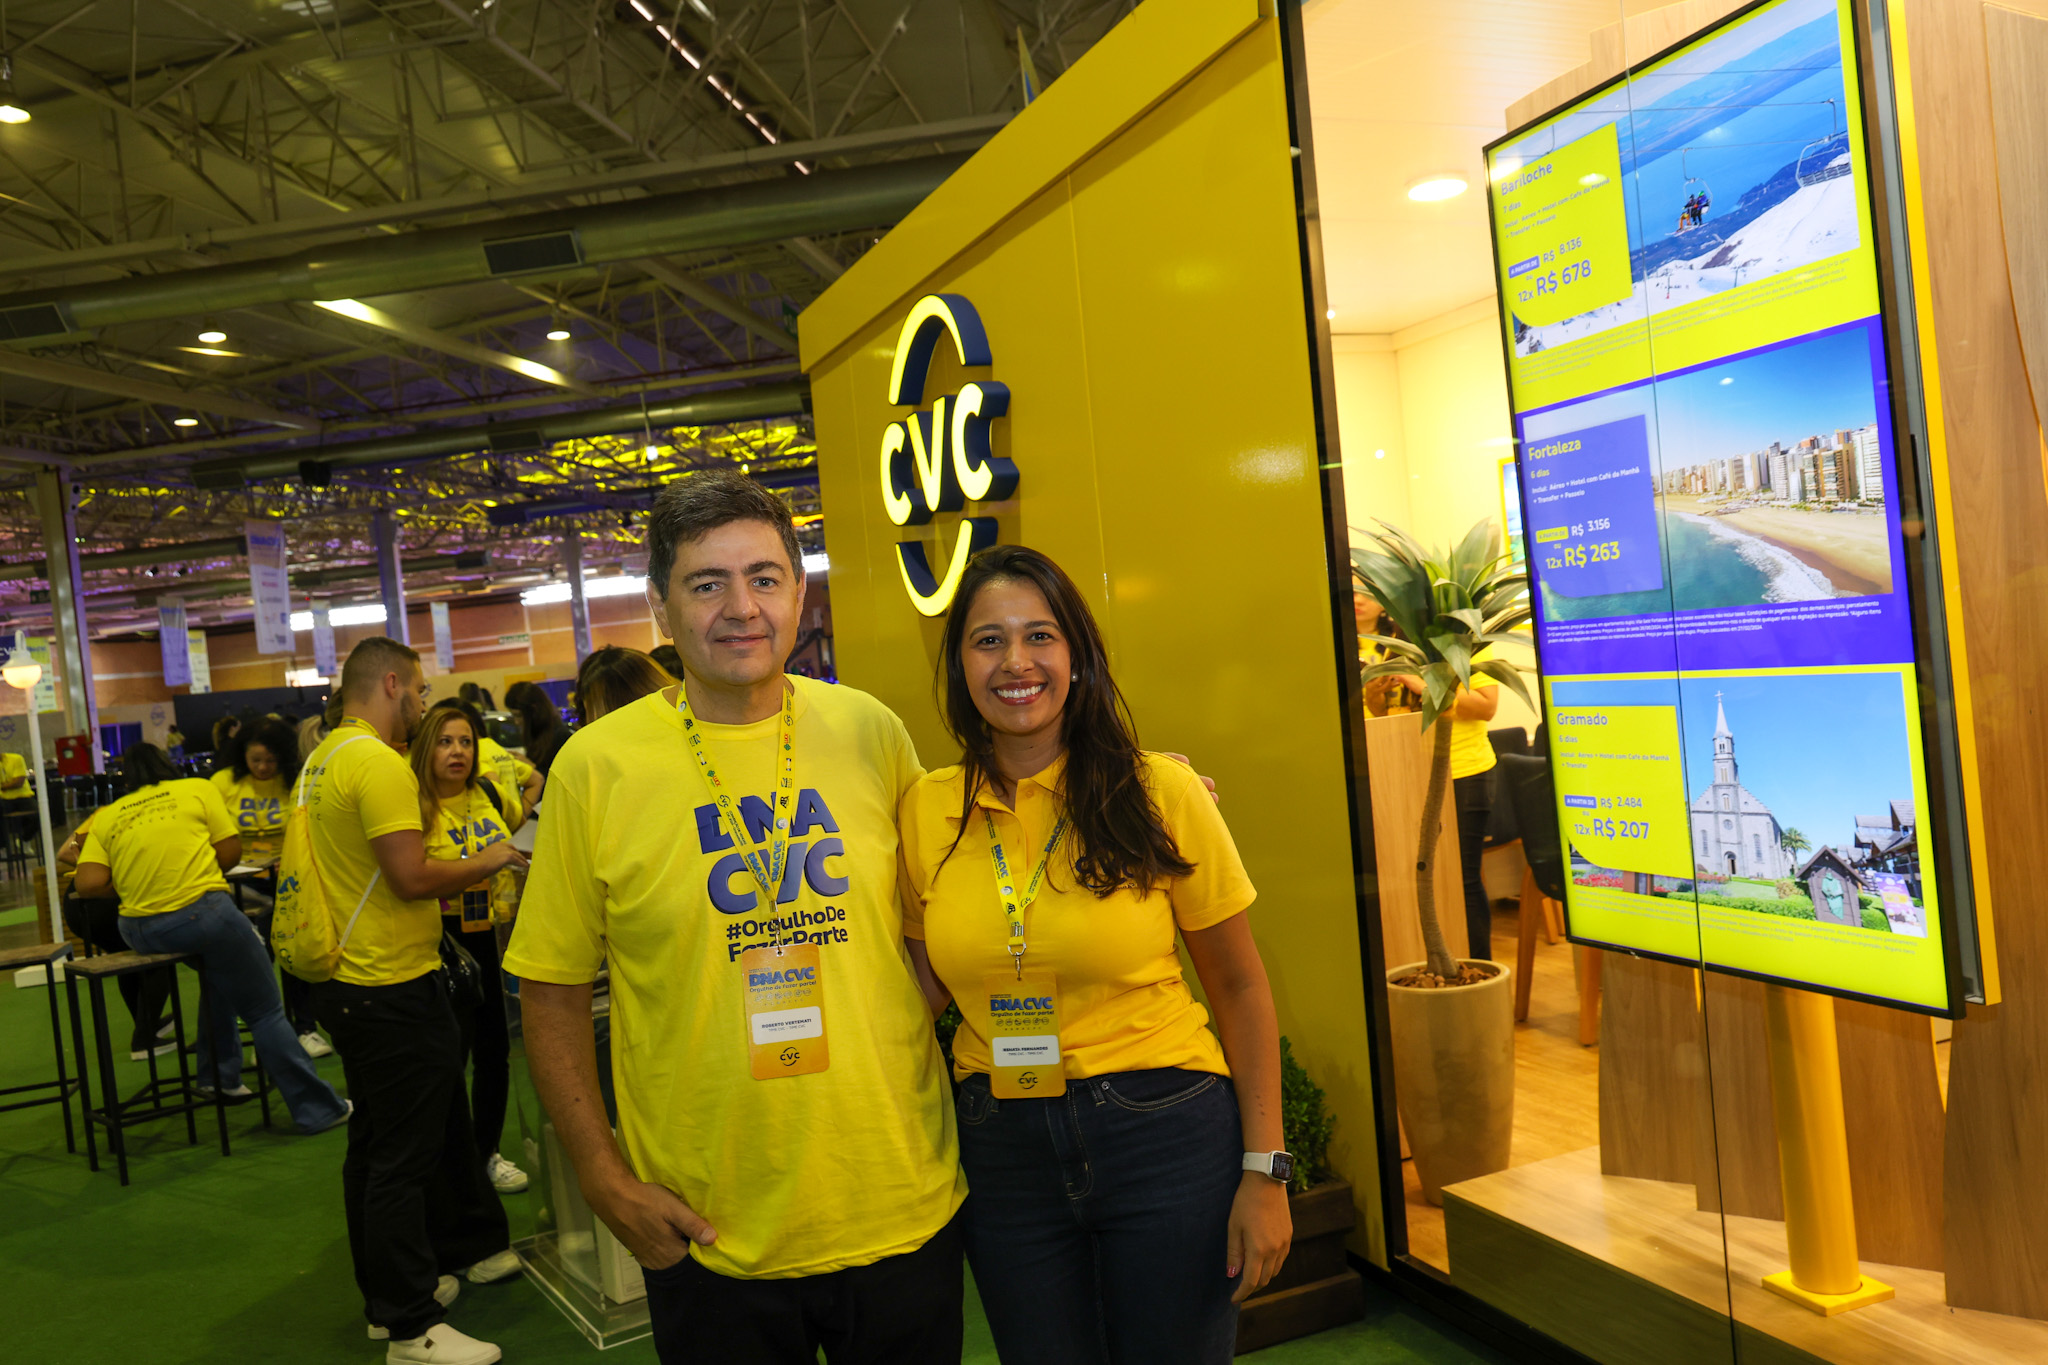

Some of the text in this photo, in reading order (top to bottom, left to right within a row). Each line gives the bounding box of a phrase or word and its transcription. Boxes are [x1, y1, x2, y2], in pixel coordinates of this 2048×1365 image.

[1501, 163, 1553, 196] Bariloche
[1503, 201, 1521, 214] 7 dias
[1543, 250, 1556, 263] R$
[1559, 236, 1583, 255] 8.136
[1518, 259, 1592, 303] 12x R$ 678
[880, 381, 1008, 525] CVC
[1528, 439, 1582, 461] Fortaleza
[1530, 469, 1550, 479] 6 dias
[1570, 477, 1586, 487] Hotel
[1538, 494, 1559, 504] Transfer
[1571, 524, 1584, 537] R$
[1587, 518, 1610, 532] 3.156
[1546, 541, 1621, 569] 12x R$ 263
[1557, 712, 1608, 726] Gramado
[1558, 735, 1563, 743] 6
[718, 793, 729, 808] CVC
[1601, 798, 1613, 809] R$
[1617, 796, 1642, 808] 2.484
[239, 811, 282, 827] CC
[694, 788, 840, 855] DNA
[1574, 817, 1650, 840] 12x R$ 207
[707, 837, 849, 915] CVC
[726, 905, 846, 940] #OrgulhoDe
[785, 1018, 812, 1026] VERTEMATI
[780, 1051, 800, 1061] CVC
